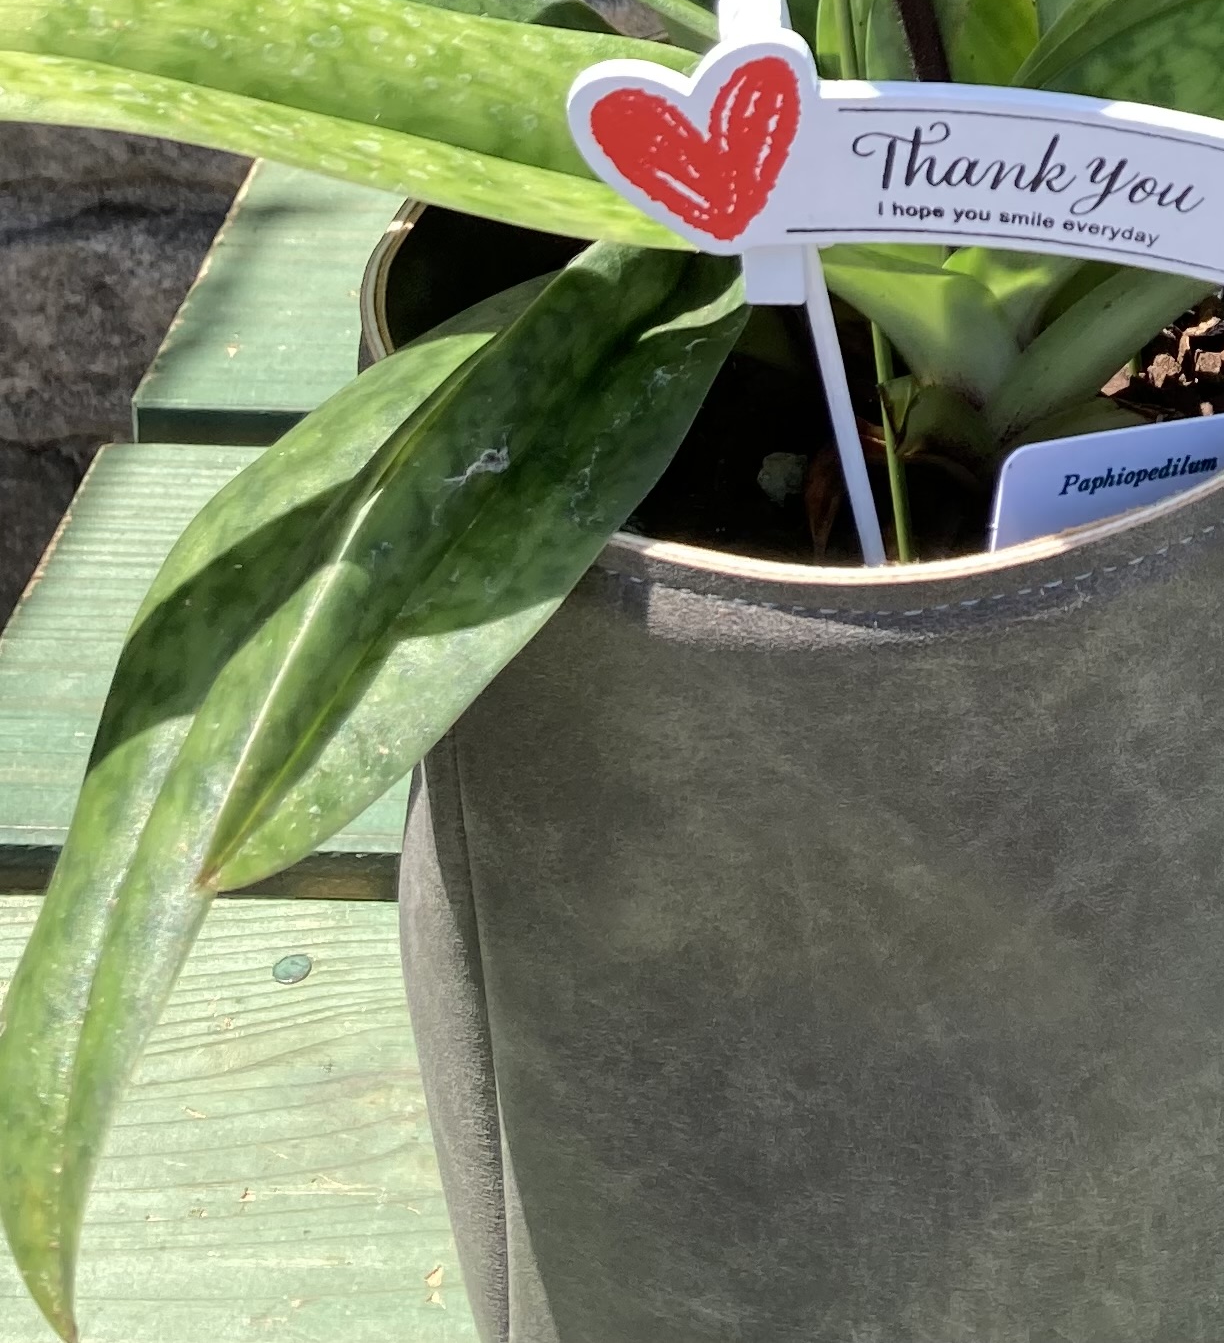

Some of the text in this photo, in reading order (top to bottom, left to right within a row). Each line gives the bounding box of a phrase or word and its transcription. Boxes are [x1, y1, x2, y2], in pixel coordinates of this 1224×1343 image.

[852, 121, 1205, 214] Thank You
[877, 201, 1161, 247] I hope you smile everyday
[1058, 454, 1218, 496] Paphiopedilum
